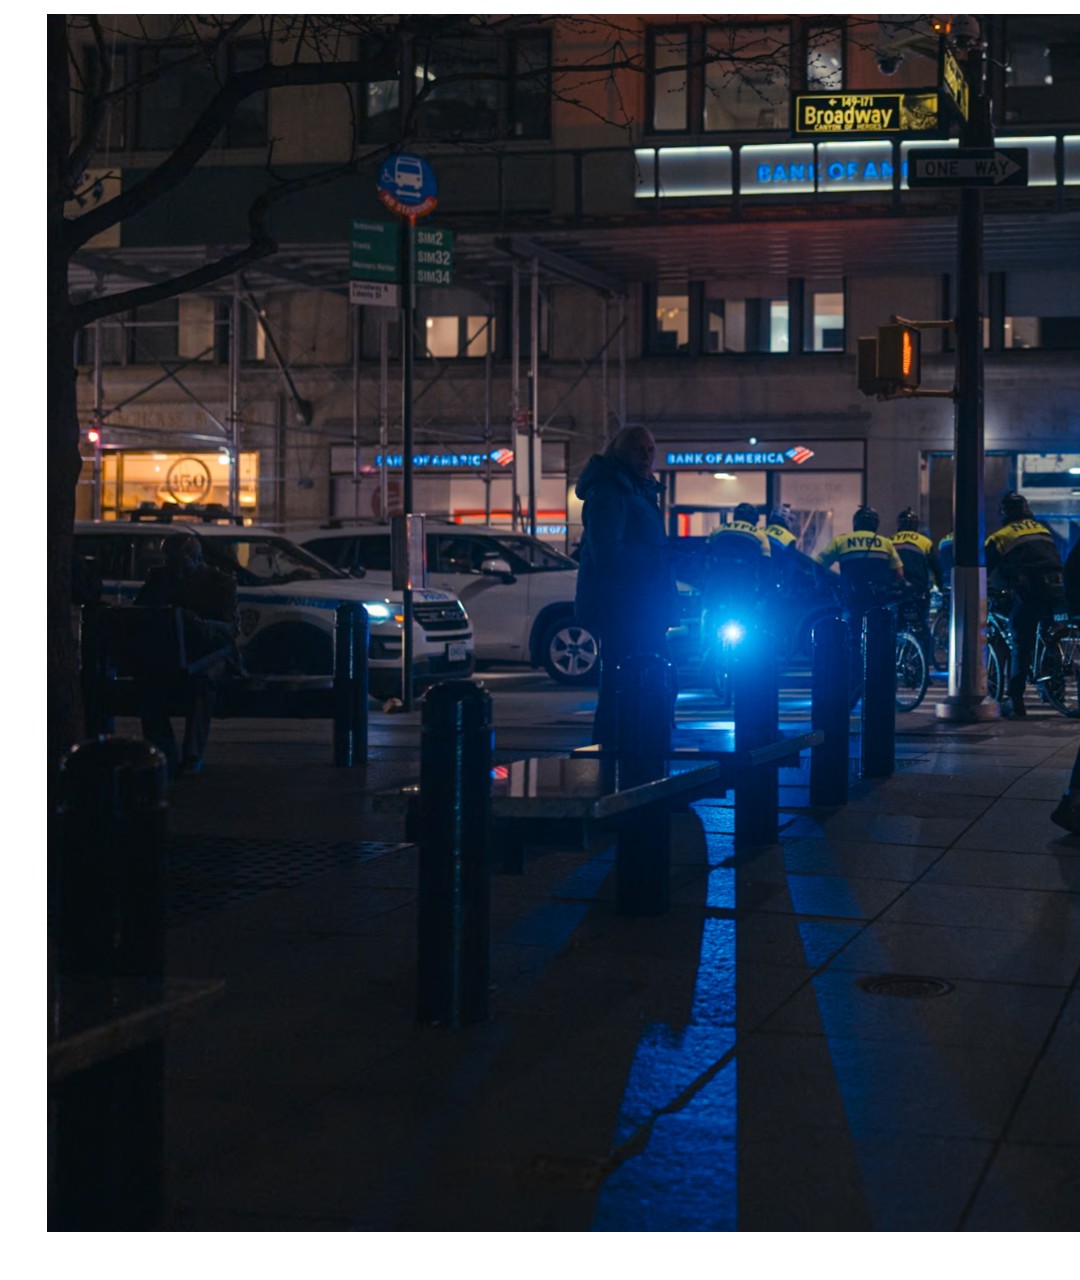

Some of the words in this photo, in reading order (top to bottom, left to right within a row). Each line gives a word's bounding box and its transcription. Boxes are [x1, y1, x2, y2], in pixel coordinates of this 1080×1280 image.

[841, 96, 874, 107] 149-171
[804, 105, 893, 128] Broadway
[814, 123, 842, 131] CANYON
[828, 161, 859, 180] OF
[924, 160, 960, 177] ONE
[974, 160, 1009, 176] WAY
[417, 231, 443, 246] SIM2
[417, 250, 451, 266] SIM32
[417, 269, 450, 284] SIM34
[667, 453, 703, 465] BANK
[705, 453, 722, 464] OF
[723, 452, 785, 464] AMERICA
[723, 522, 758, 533] NYPD
[1011, 519, 1039, 532] NYP
[847, 536, 883, 548] NYPD
[889, 532, 919, 541] NYPD
